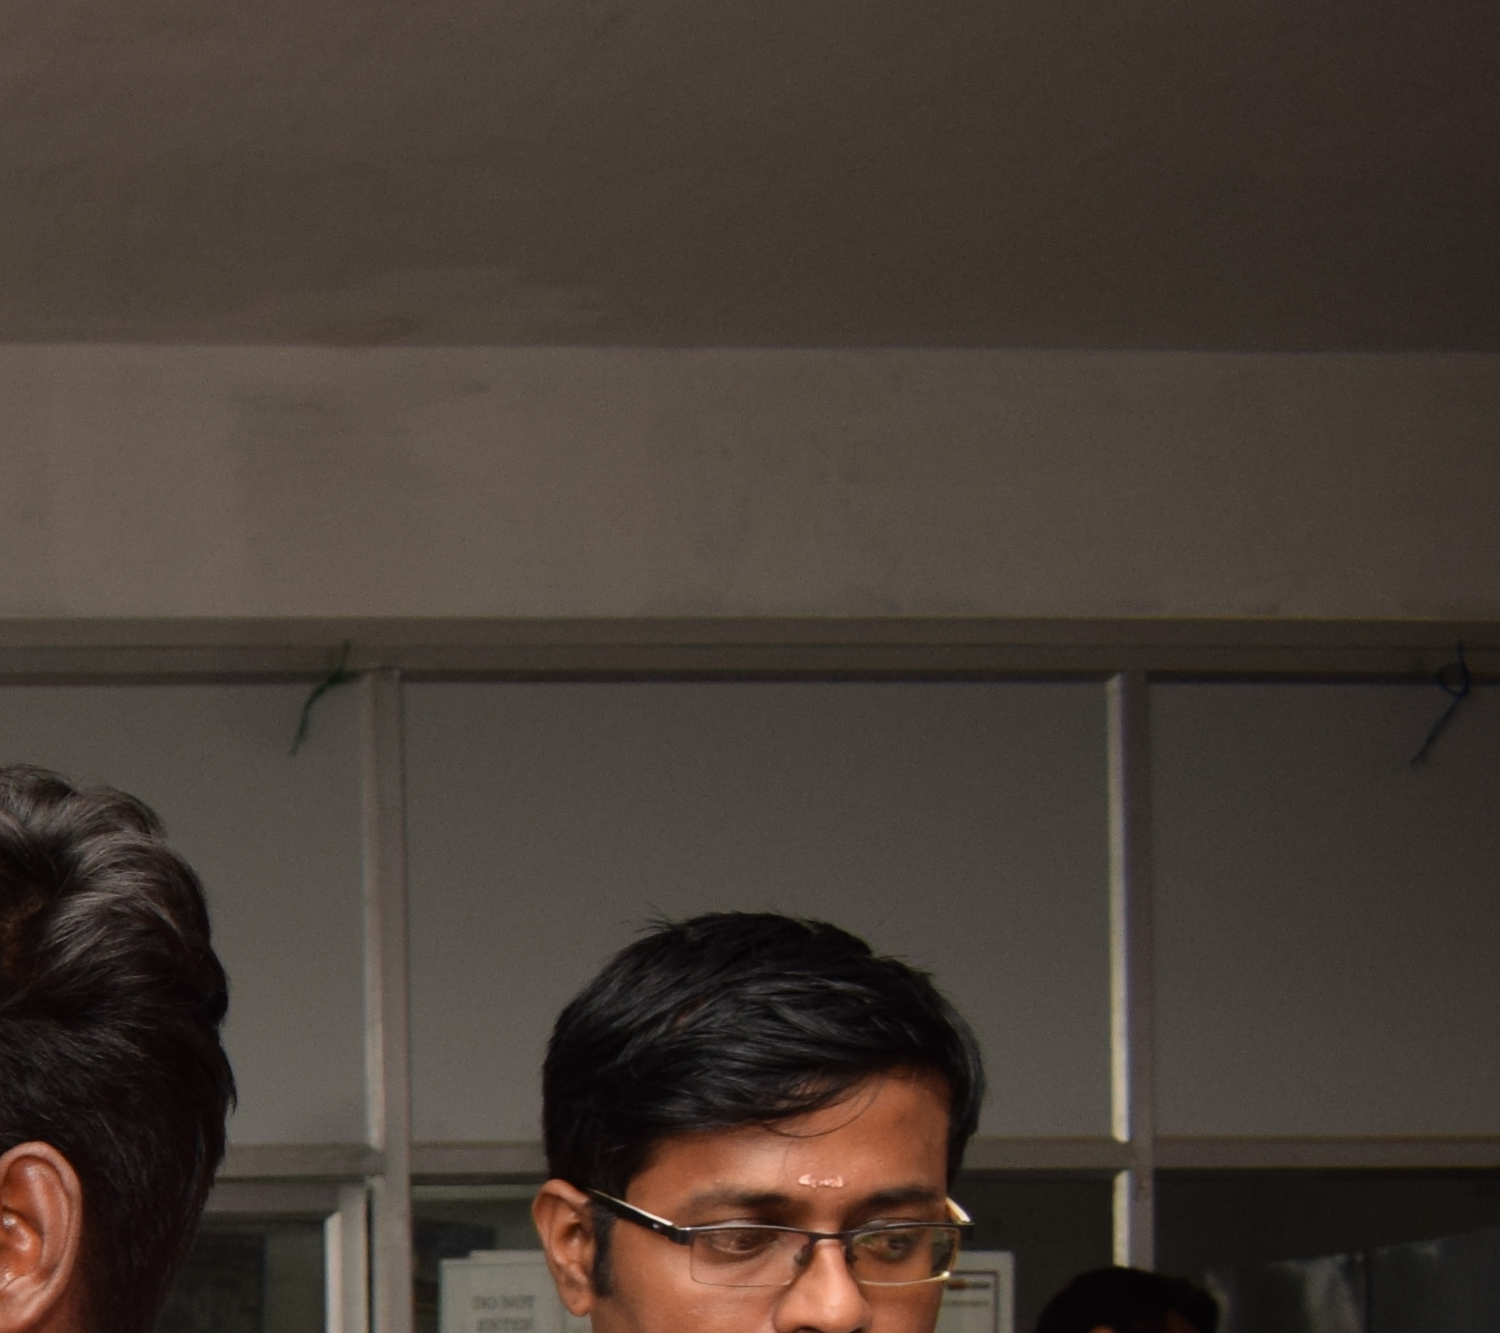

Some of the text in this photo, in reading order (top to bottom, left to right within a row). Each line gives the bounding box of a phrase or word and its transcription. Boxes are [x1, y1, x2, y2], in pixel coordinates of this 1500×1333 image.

[473, 1294, 535, 1309] DO NOT
[477, 1317, 534, 1332] ENTER
